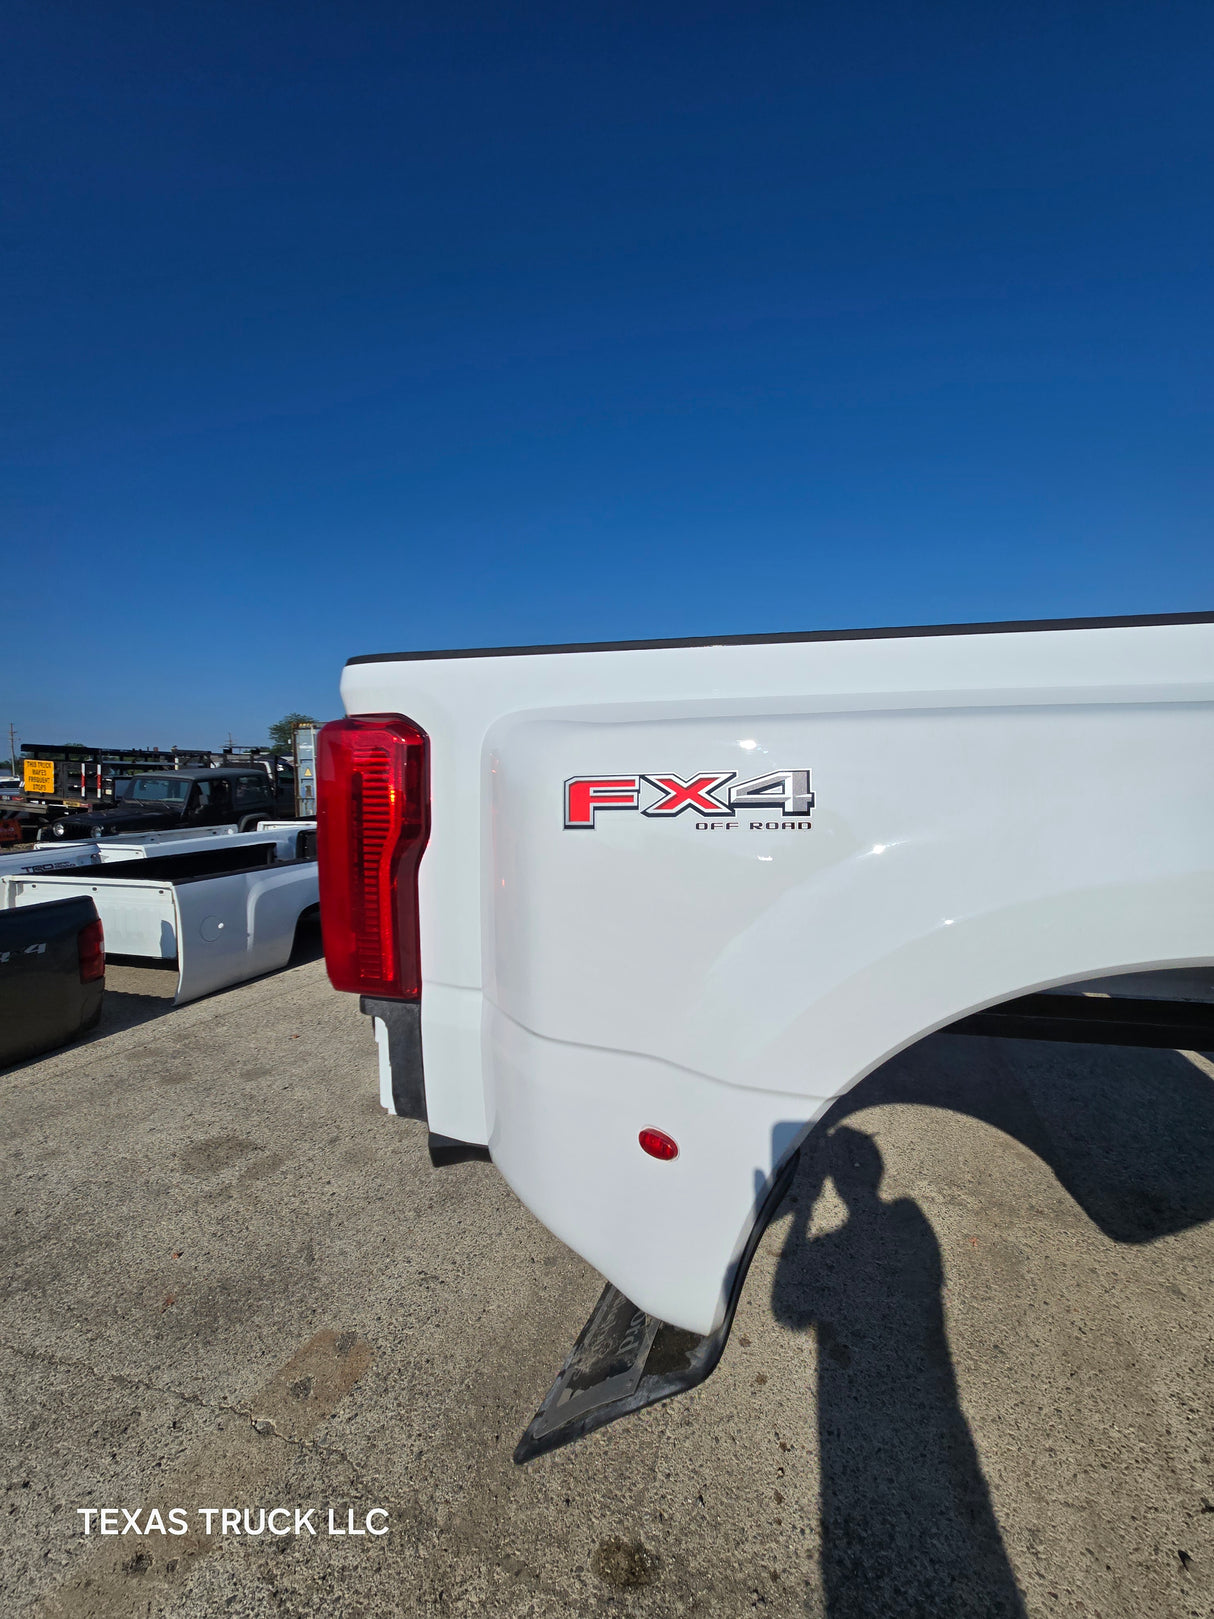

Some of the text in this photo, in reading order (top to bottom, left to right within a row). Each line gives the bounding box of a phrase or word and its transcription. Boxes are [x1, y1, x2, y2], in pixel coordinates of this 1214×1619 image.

[37, 761, 52, 769] TRUCK
[563, 768, 816, 830] FX4
[695, 821, 812, 830] OFF ROAD
